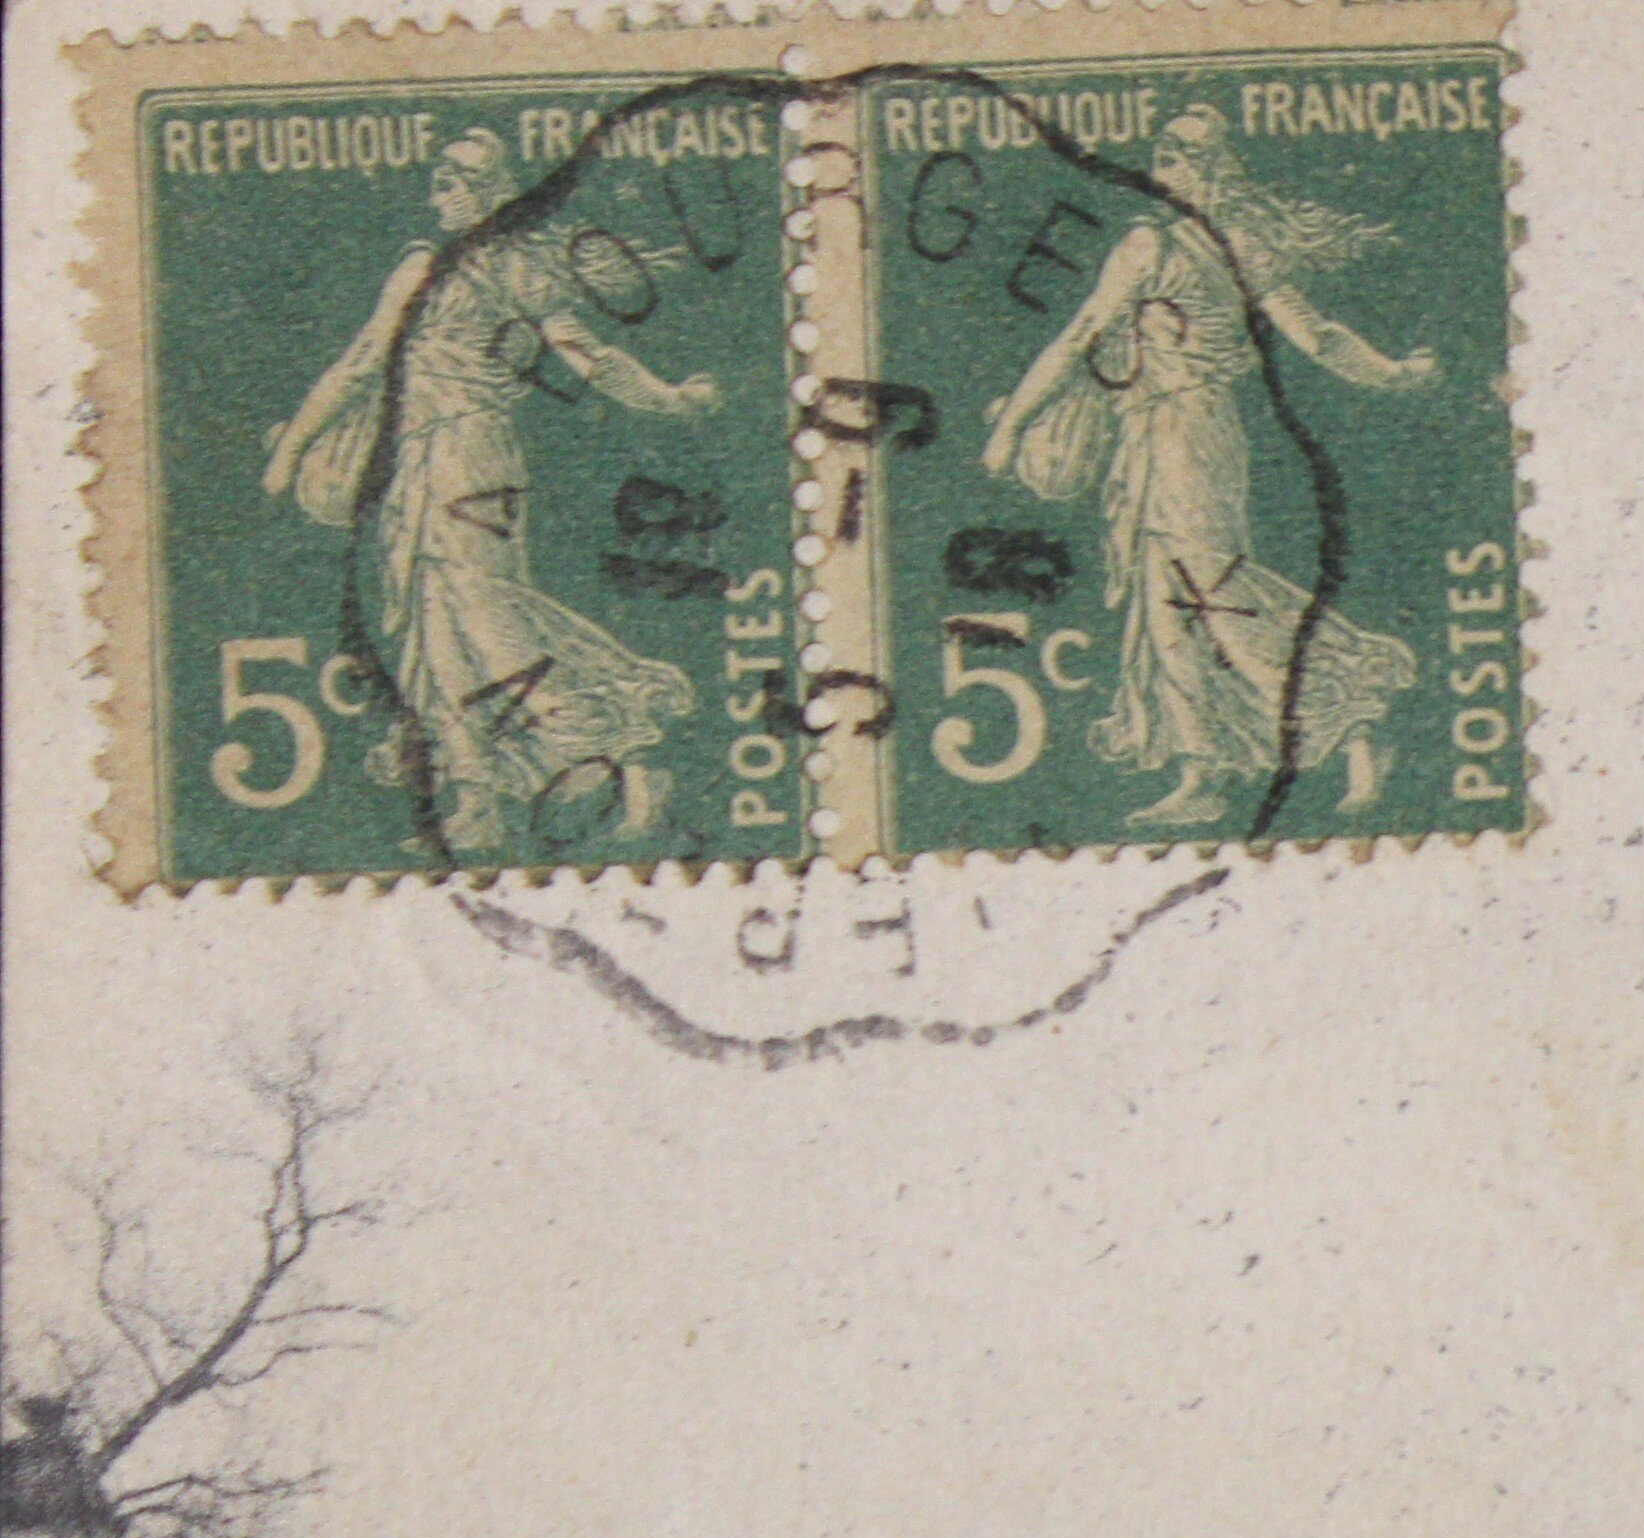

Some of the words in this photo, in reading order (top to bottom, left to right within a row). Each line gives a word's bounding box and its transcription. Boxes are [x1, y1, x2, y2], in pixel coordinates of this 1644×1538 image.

[518, 102, 770, 168] FRANÇAISE
[1240, 76, 1491, 141] FRANÇAISE
[724, 568, 789, 827] POSTES
[1445, 541, 1511, 800] POSTES
